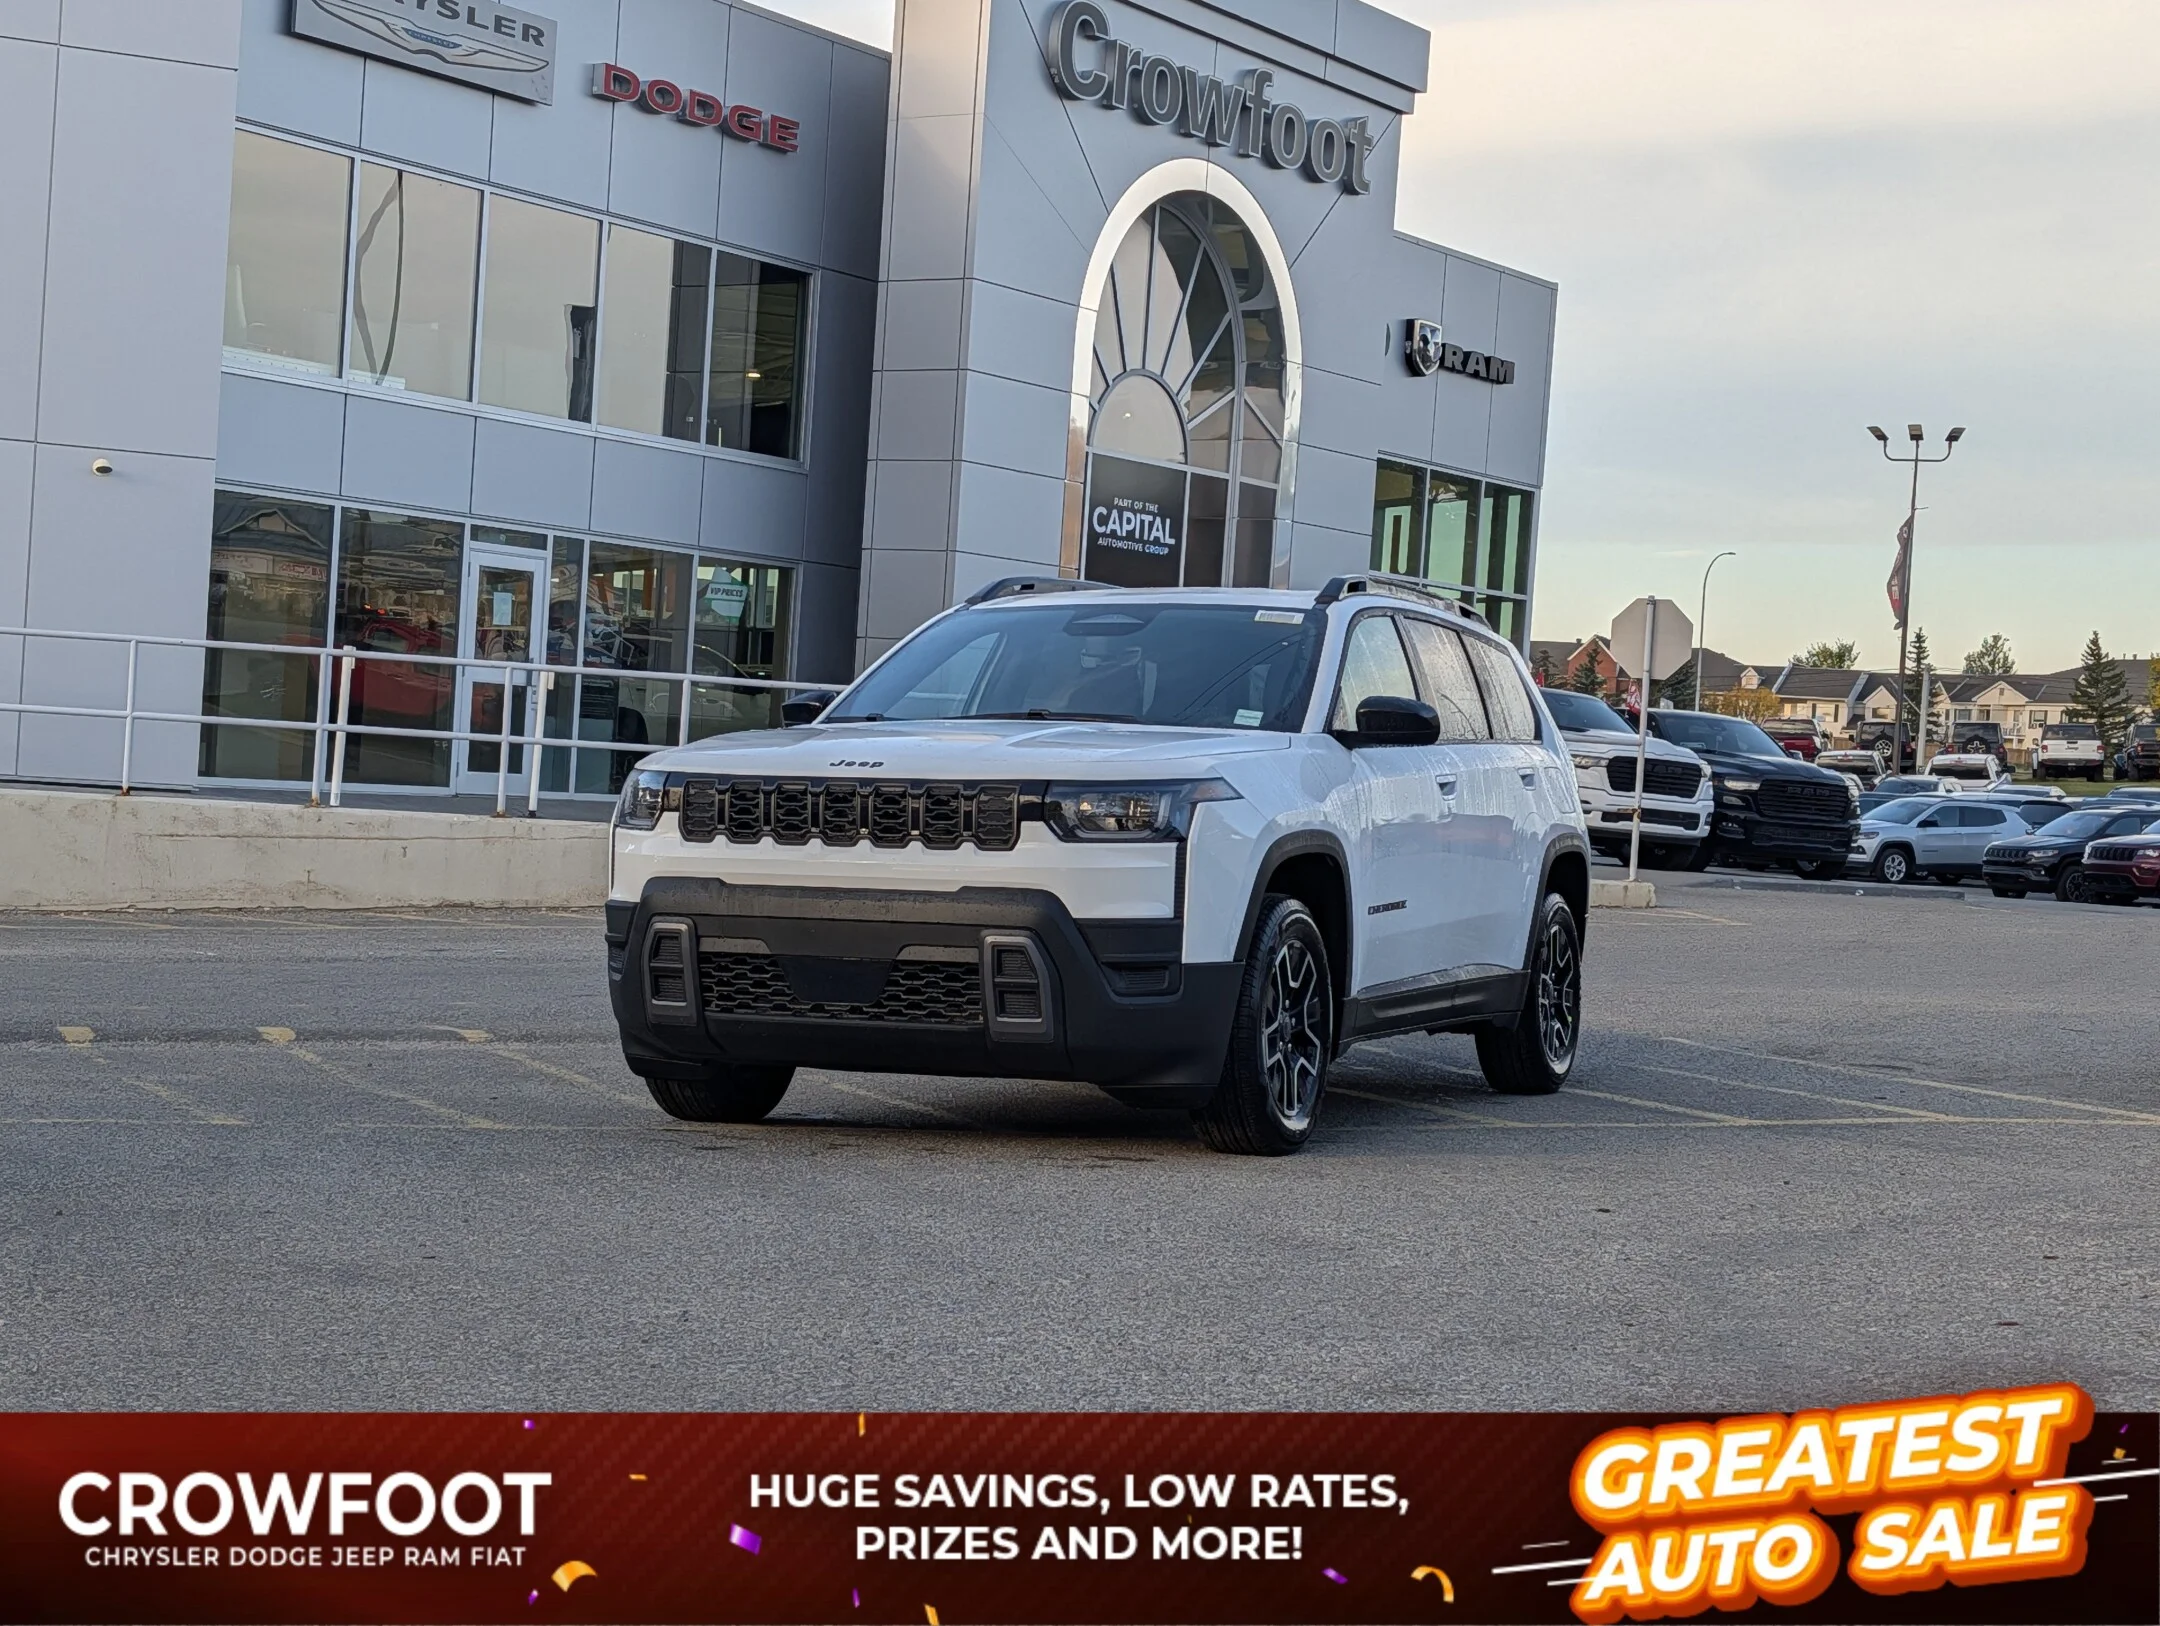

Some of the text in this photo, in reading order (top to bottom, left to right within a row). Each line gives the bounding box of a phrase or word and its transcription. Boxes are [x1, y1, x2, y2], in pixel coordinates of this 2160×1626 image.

[601, 63, 800, 152] DODGE
[1055, 0, 1374, 195] Crowfoot
[1443, 343, 1515, 385] RAM
[1113, 497, 1159, 513] PART OF THE
[1092, 506, 1176, 545] CAPITAL
[1097, 537, 1169, 556] AUTOMOTIVE GROUP
[829, 759, 885, 769] Jeep
